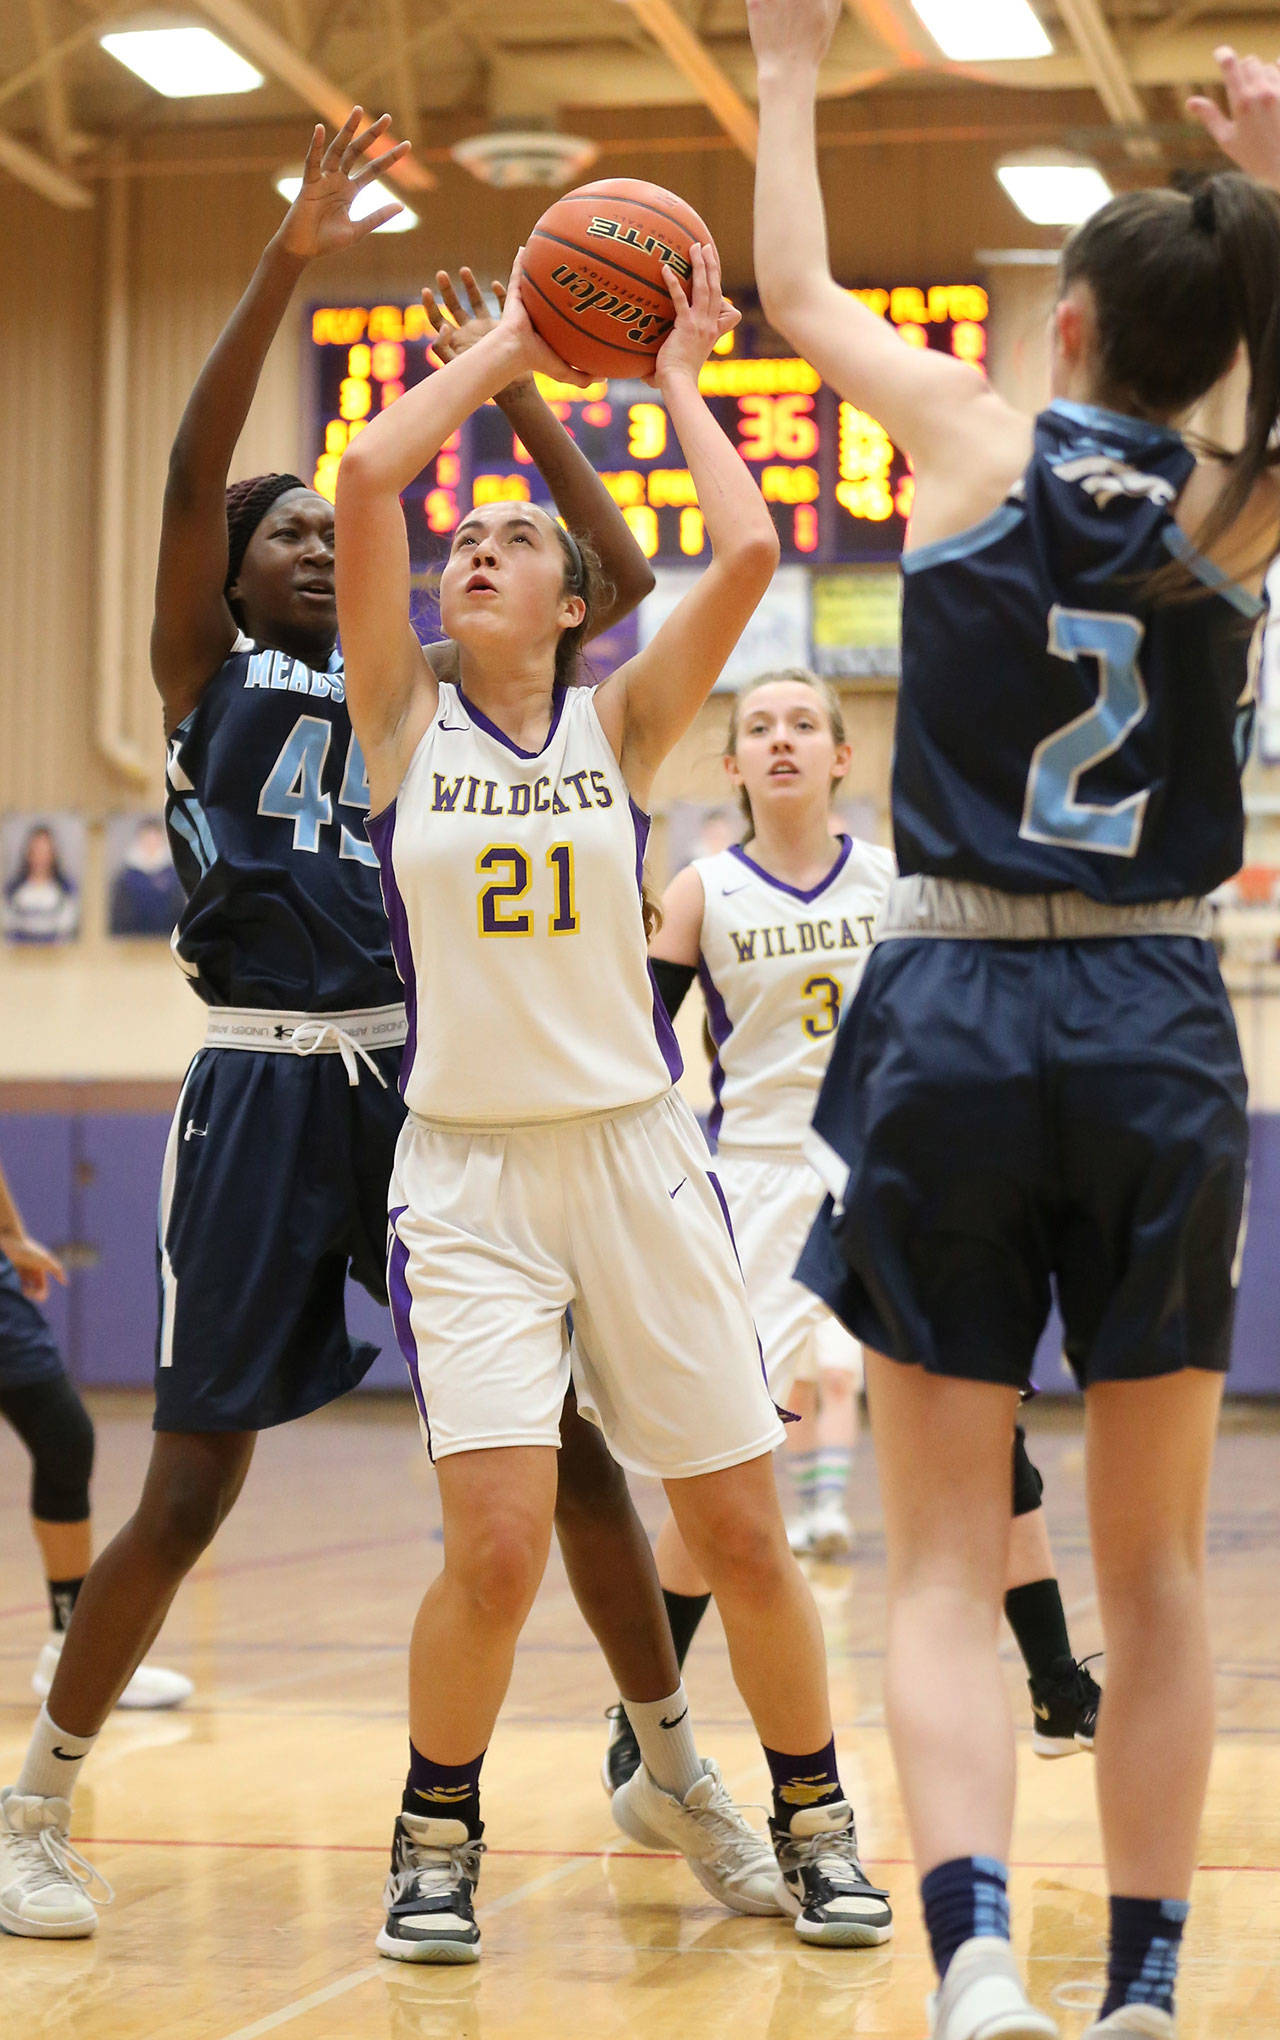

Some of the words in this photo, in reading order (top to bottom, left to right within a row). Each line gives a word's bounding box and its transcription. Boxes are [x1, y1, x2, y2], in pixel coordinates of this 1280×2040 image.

[586, 216, 692, 281] ELITE
[551, 264, 675, 345] Baden
[737, 392, 820, 461] 36
[1018, 603, 1151, 857] 2
[431, 770, 614, 816] WILDCATS
[475, 841, 581, 938] 21
[801, 973, 844, 1042] 3
